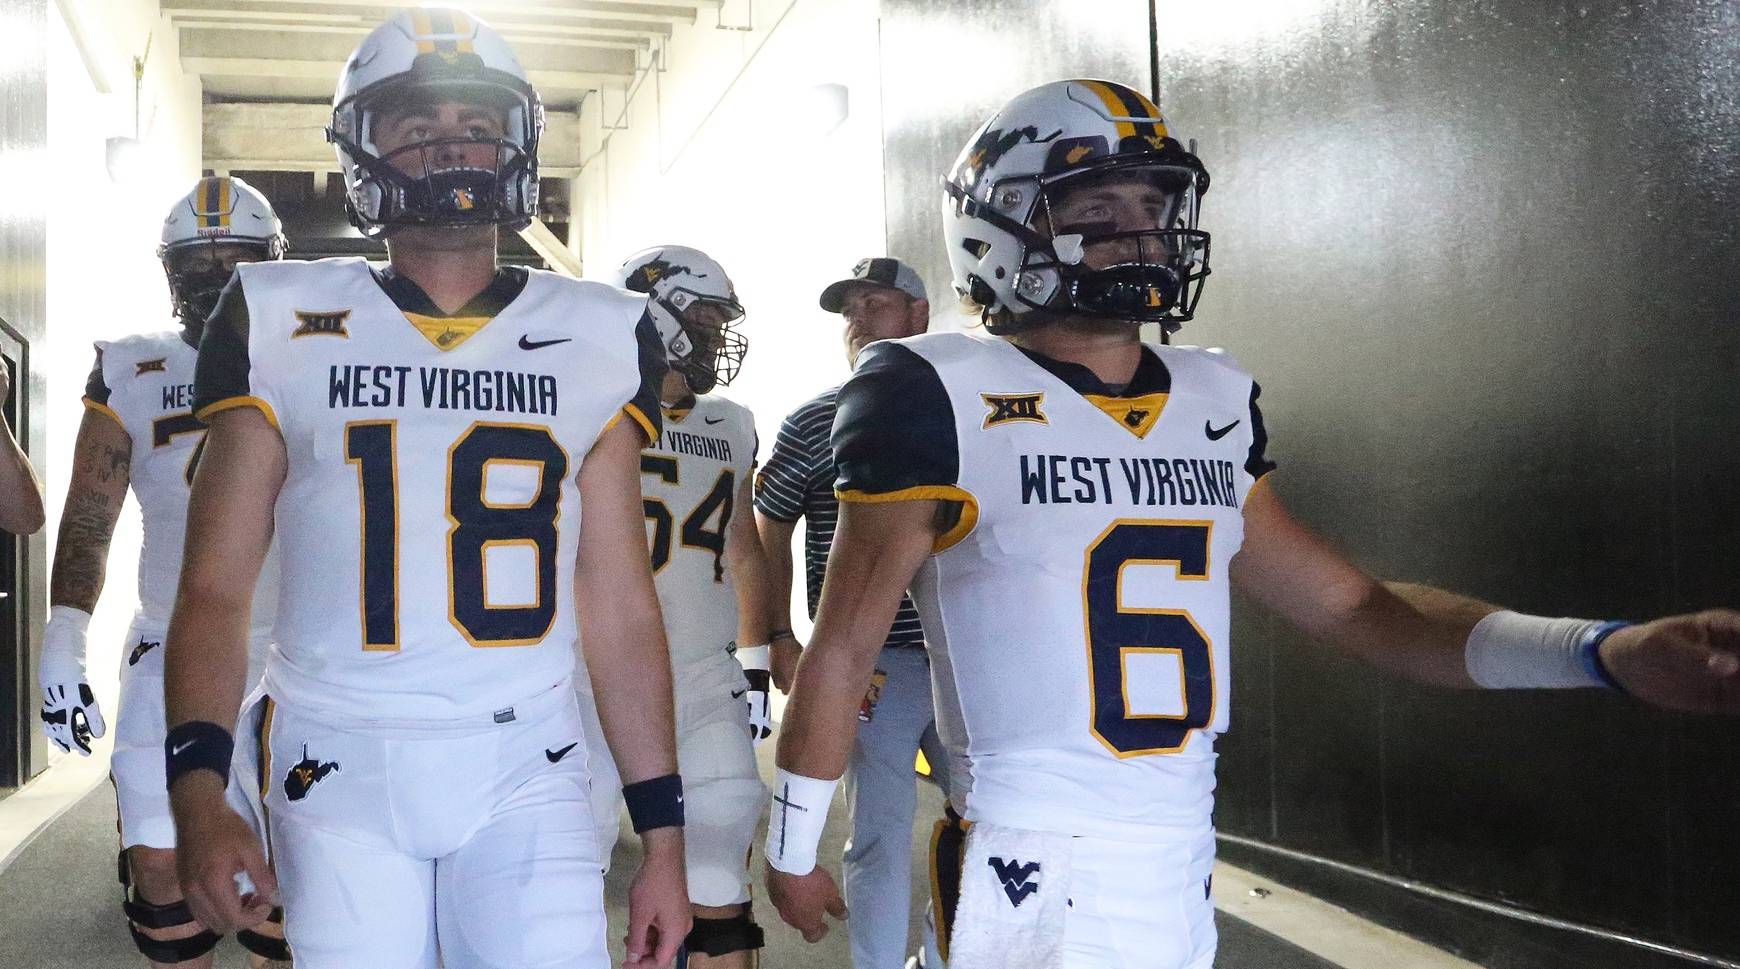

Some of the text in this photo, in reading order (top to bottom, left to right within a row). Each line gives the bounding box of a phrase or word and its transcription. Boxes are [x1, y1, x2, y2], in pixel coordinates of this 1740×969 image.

[162, 384, 195, 409] WES
[329, 365, 557, 416] WEST VIRGINIA
[667, 430, 732, 462] VIRGINIA
[1020, 455, 1238, 509] WEST VIRGINIA
[344, 419, 570, 651] 18
[1082, 518, 1216, 759] 6
